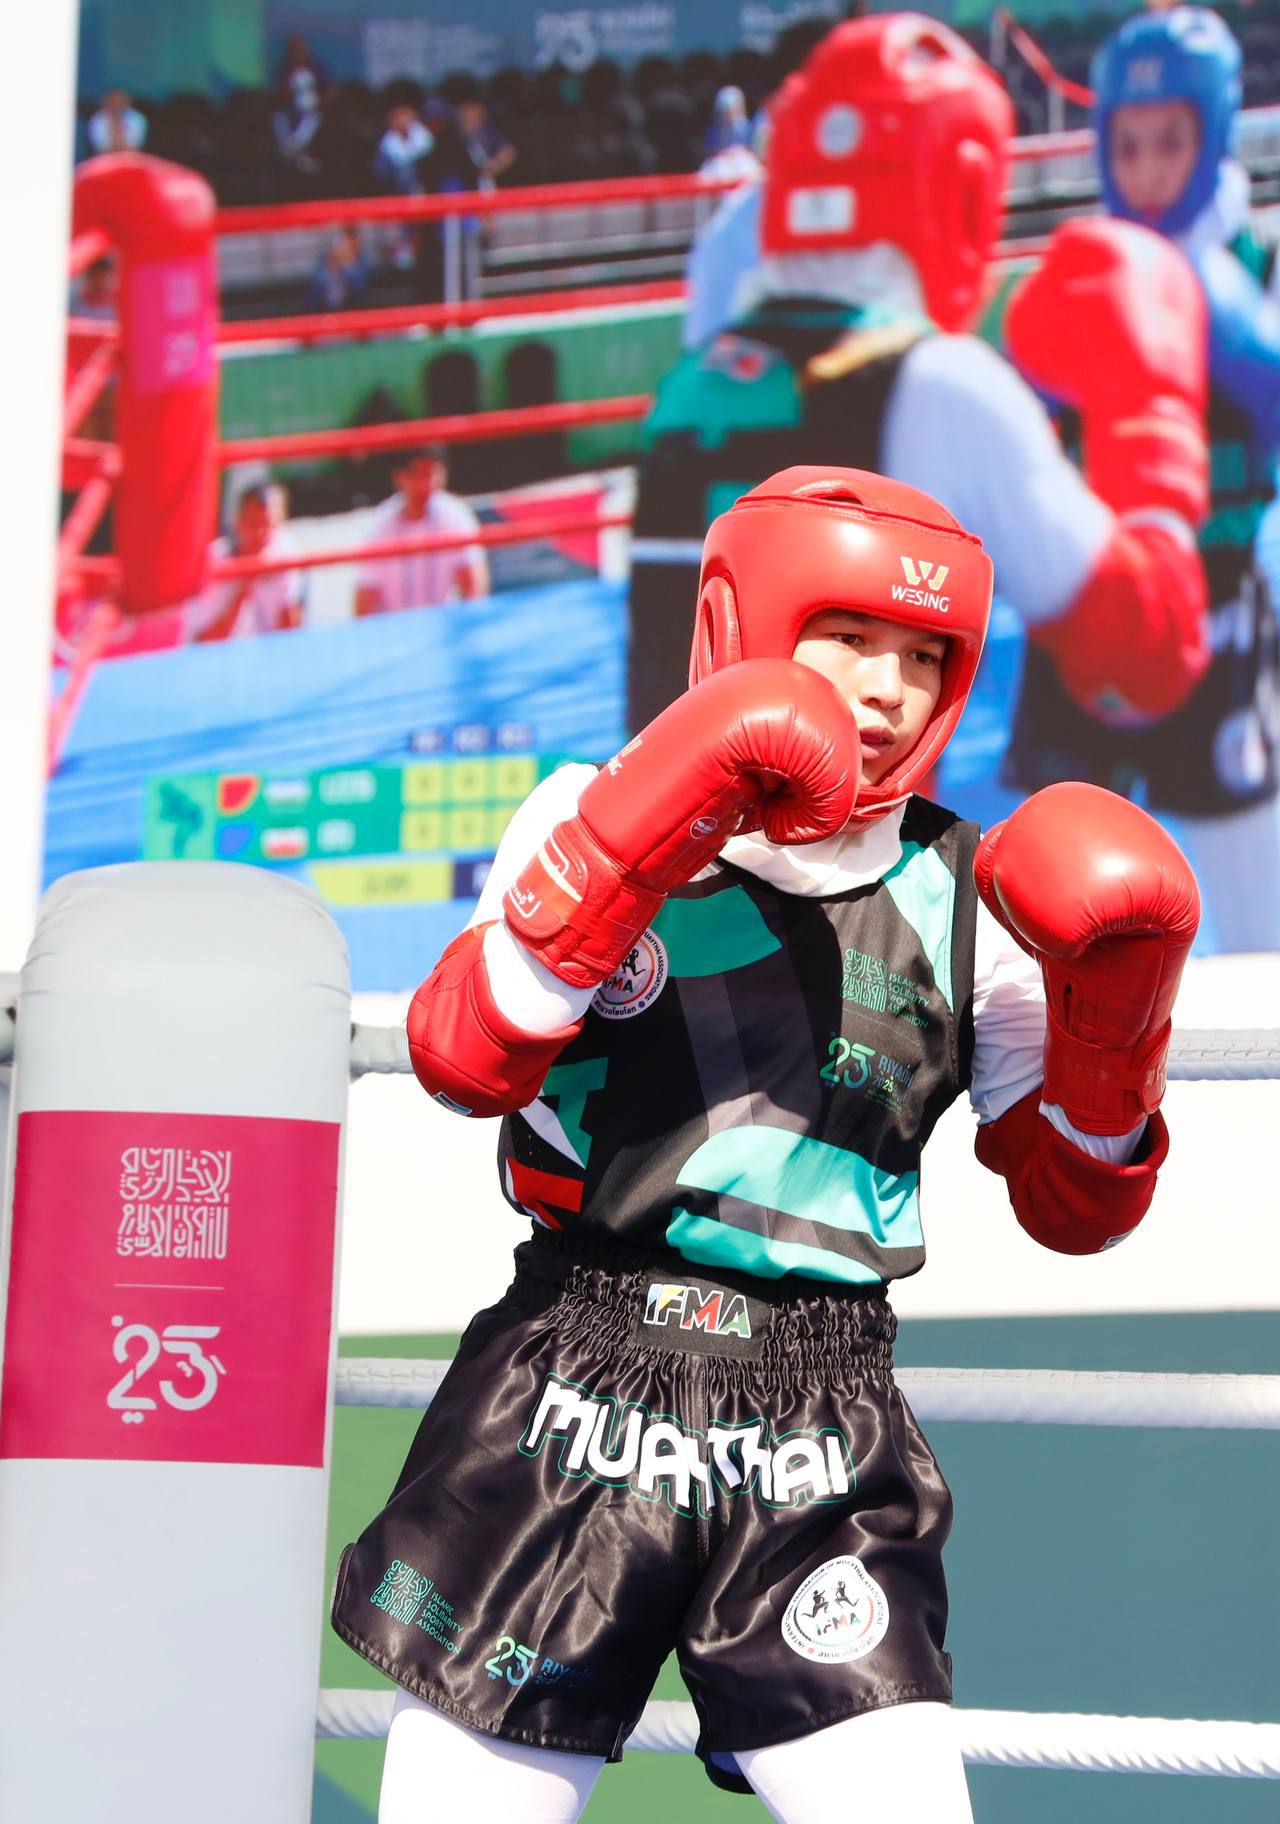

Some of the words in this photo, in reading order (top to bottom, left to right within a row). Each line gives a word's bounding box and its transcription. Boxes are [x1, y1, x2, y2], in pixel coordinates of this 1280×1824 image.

[891, 584, 950, 613] WESING
[643, 931, 663, 956] UAYTHAI
[819, 1034, 876, 1089] 25
[643, 1283, 753, 1340] IFMA
[107, 1316, 227, 1424] 25
[415, 1617, 462, 1656] ASSOCIATION
